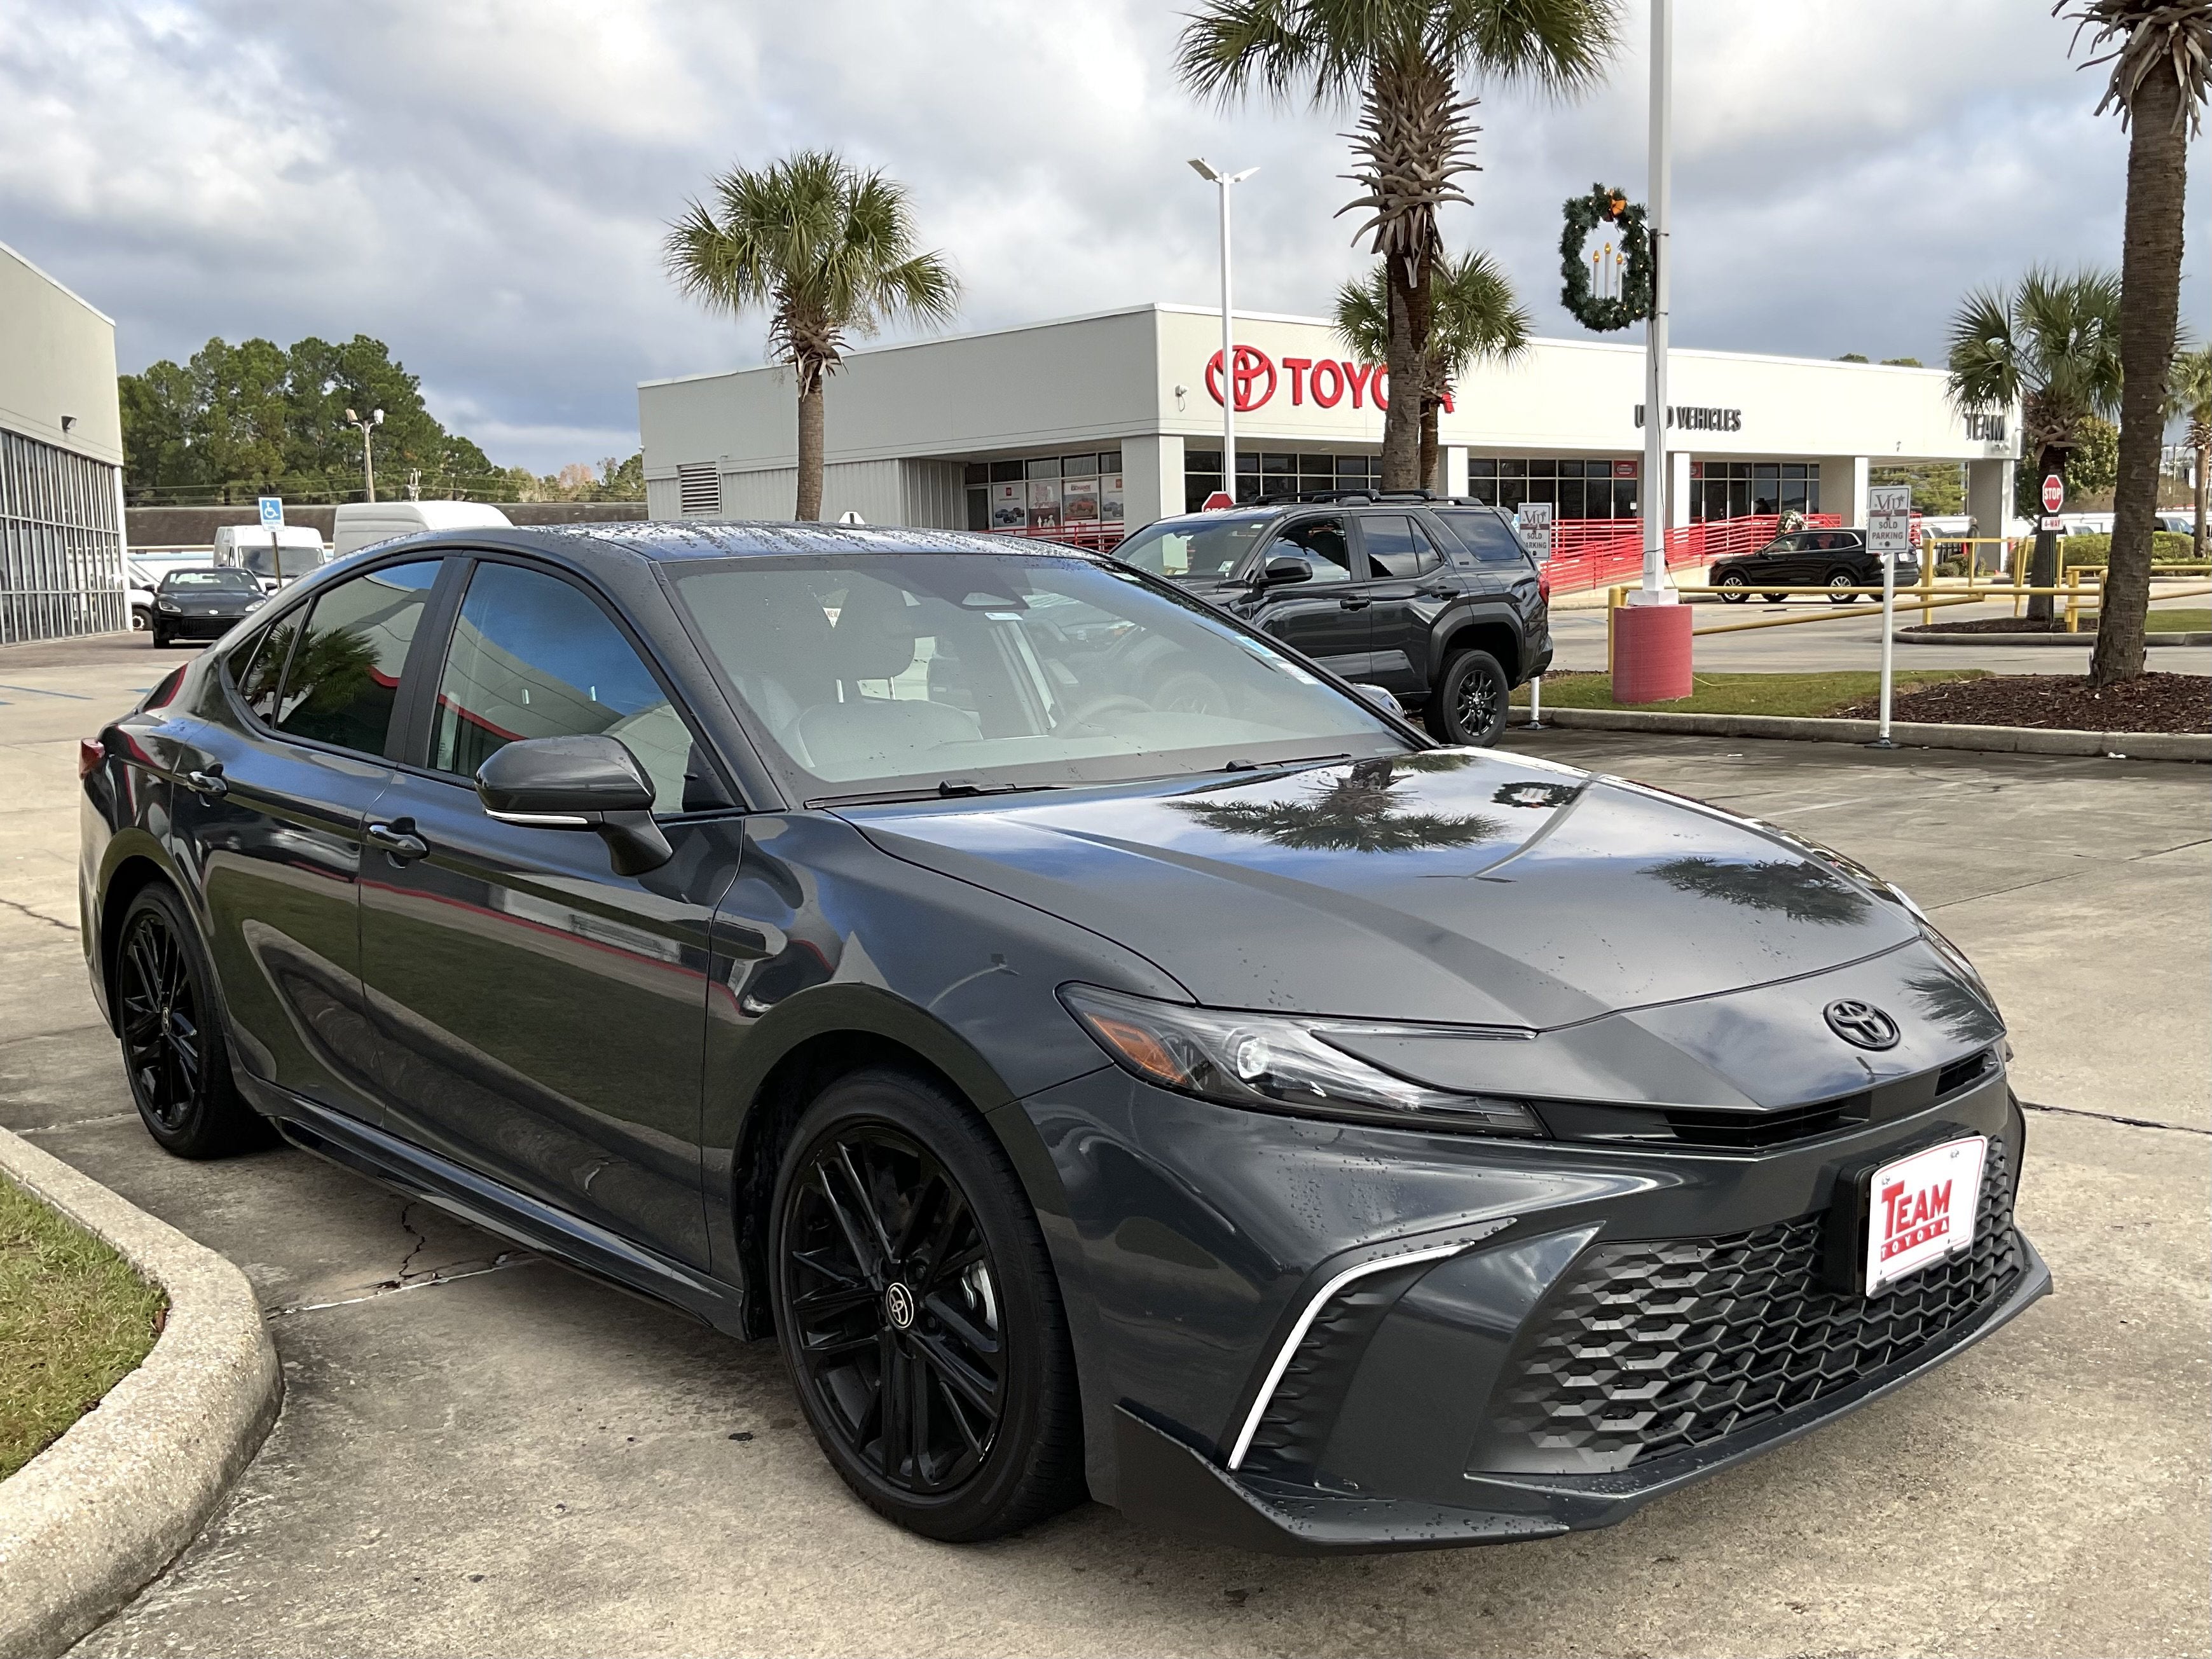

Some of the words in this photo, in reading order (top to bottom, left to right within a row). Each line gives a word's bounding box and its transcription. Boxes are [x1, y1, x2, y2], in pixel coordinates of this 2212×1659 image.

[1282, 357, 1455, 413] TOYO
[1635, 404, 1674, 429] UD
[1676, 406, 1741, 432] VEHICLES
[1963, 413, 2005, 441] TEAM
[2044, 487, 2061, 500] STOP
[2044, 519, 2061, 528] 4-WAY
[1881, 1179, 1953, 1241] TEAM
[1881, 1219, 1948, 1258] TOYOTA
